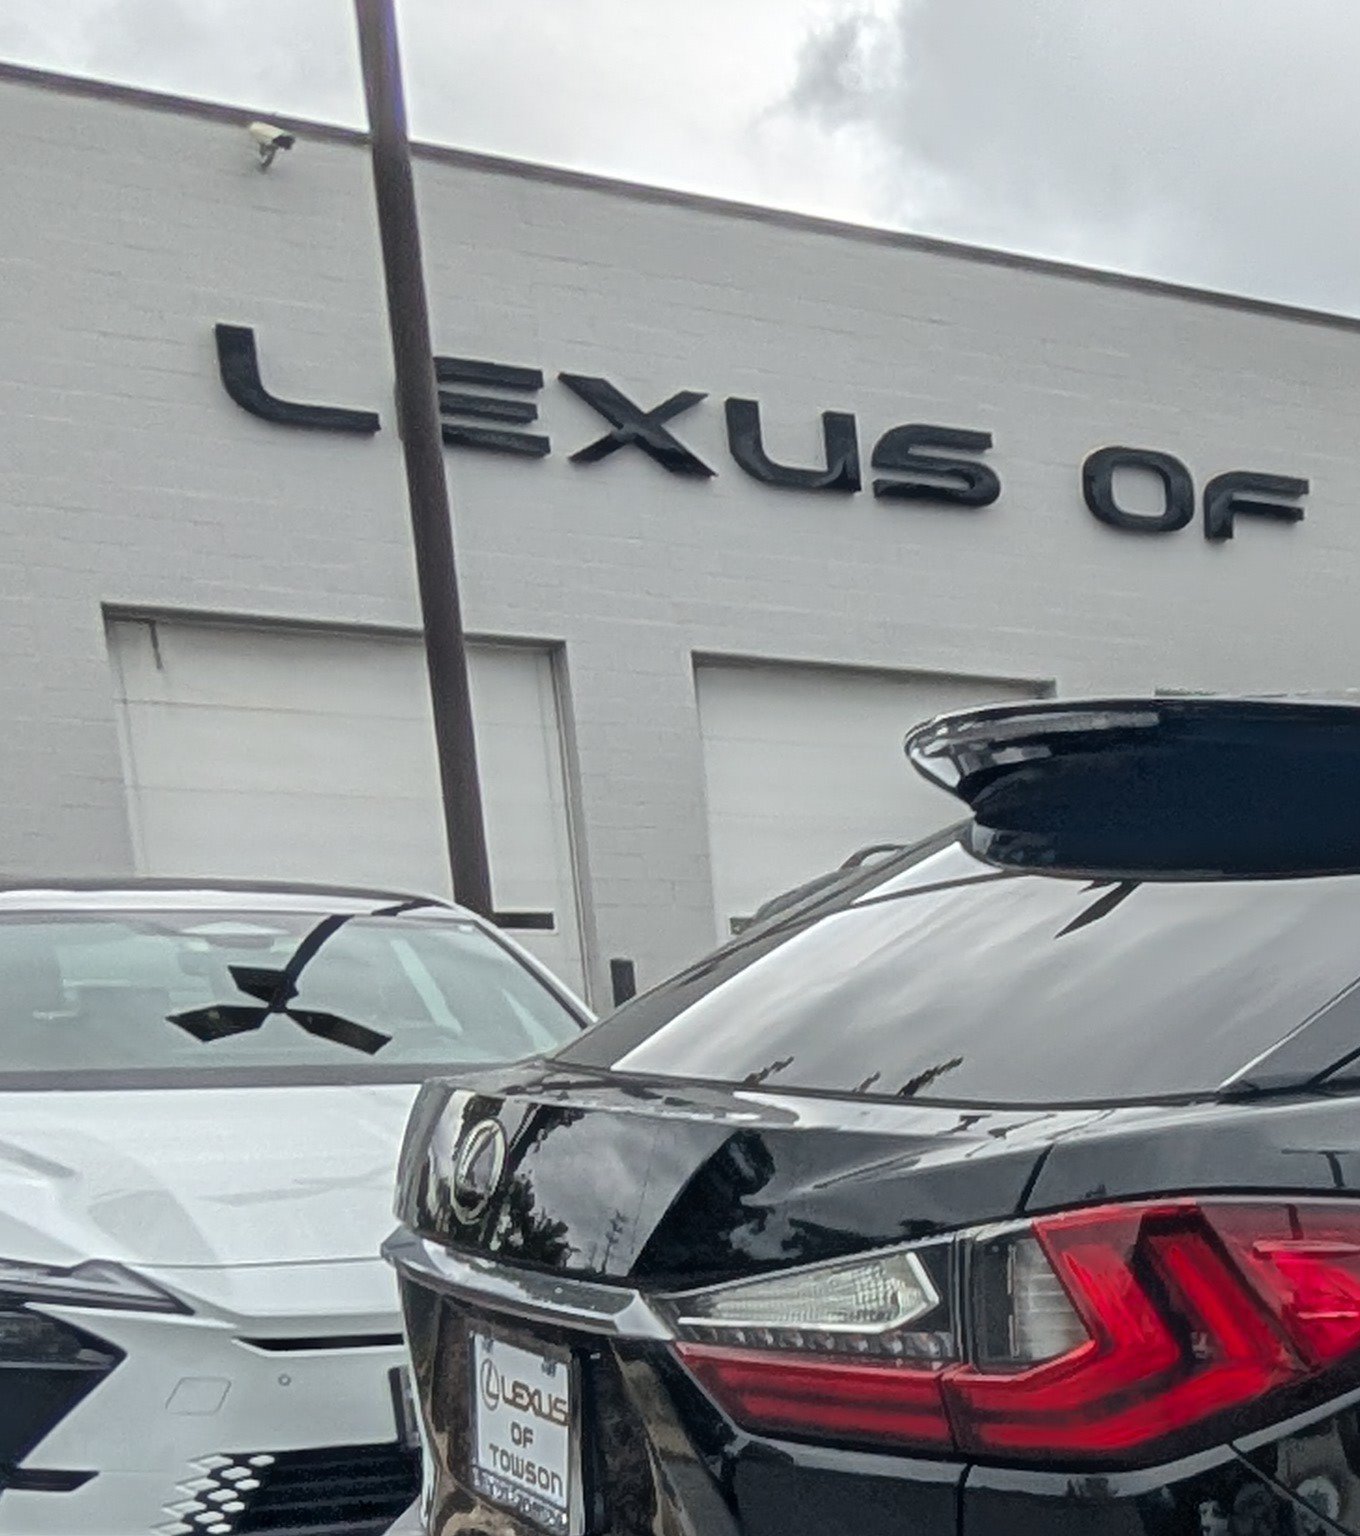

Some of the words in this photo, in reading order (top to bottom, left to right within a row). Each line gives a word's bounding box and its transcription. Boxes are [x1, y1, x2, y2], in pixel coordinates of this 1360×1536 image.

[215, 324, 1000, 507] LEXUS
[1082, 444, 1310, 543] OF
[500, 1375, 569, 1427] LEXUS
[510, 1420, 534, 1449] OF
[489, 1443, 563, 1498] TOWSON
